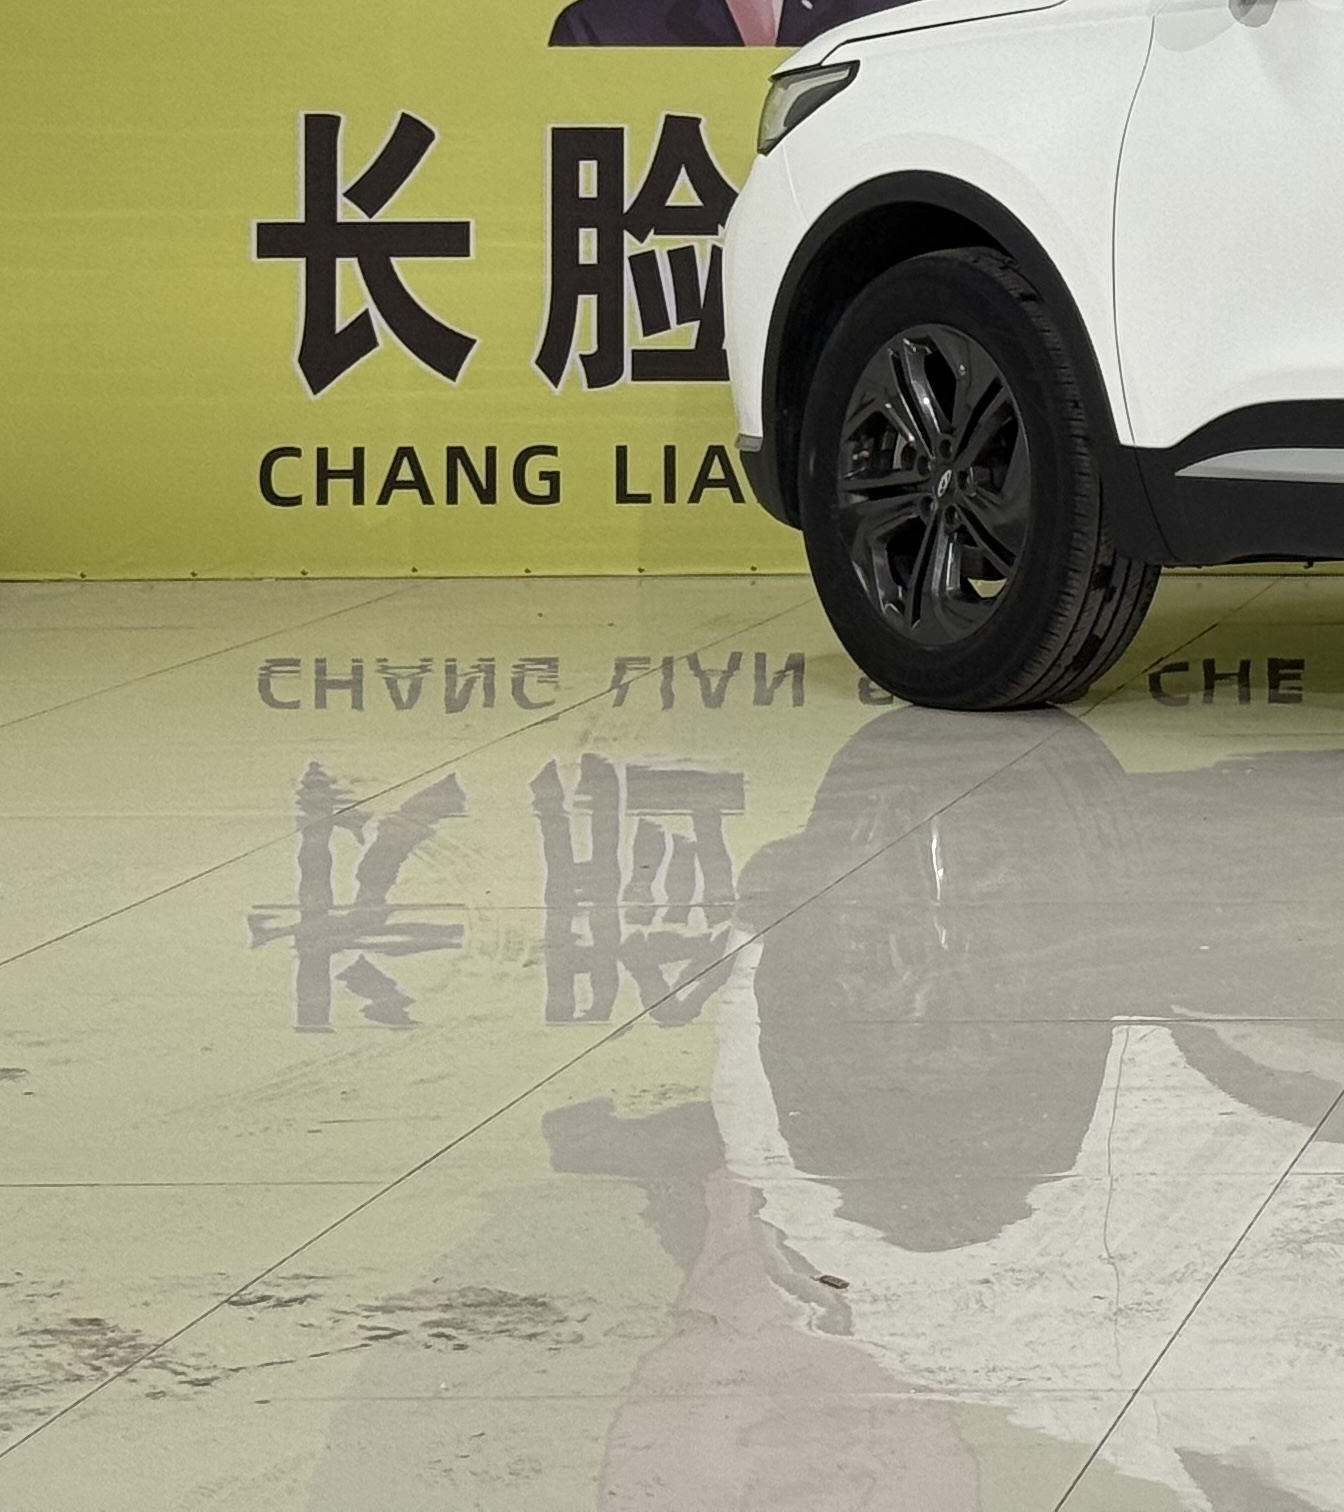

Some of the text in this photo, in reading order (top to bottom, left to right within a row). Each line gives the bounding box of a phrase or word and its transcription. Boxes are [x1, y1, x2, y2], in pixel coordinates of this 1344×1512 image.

[256, 110, 740, 396] 长脸
[258, 444, 752, 507] CHANG LIA
